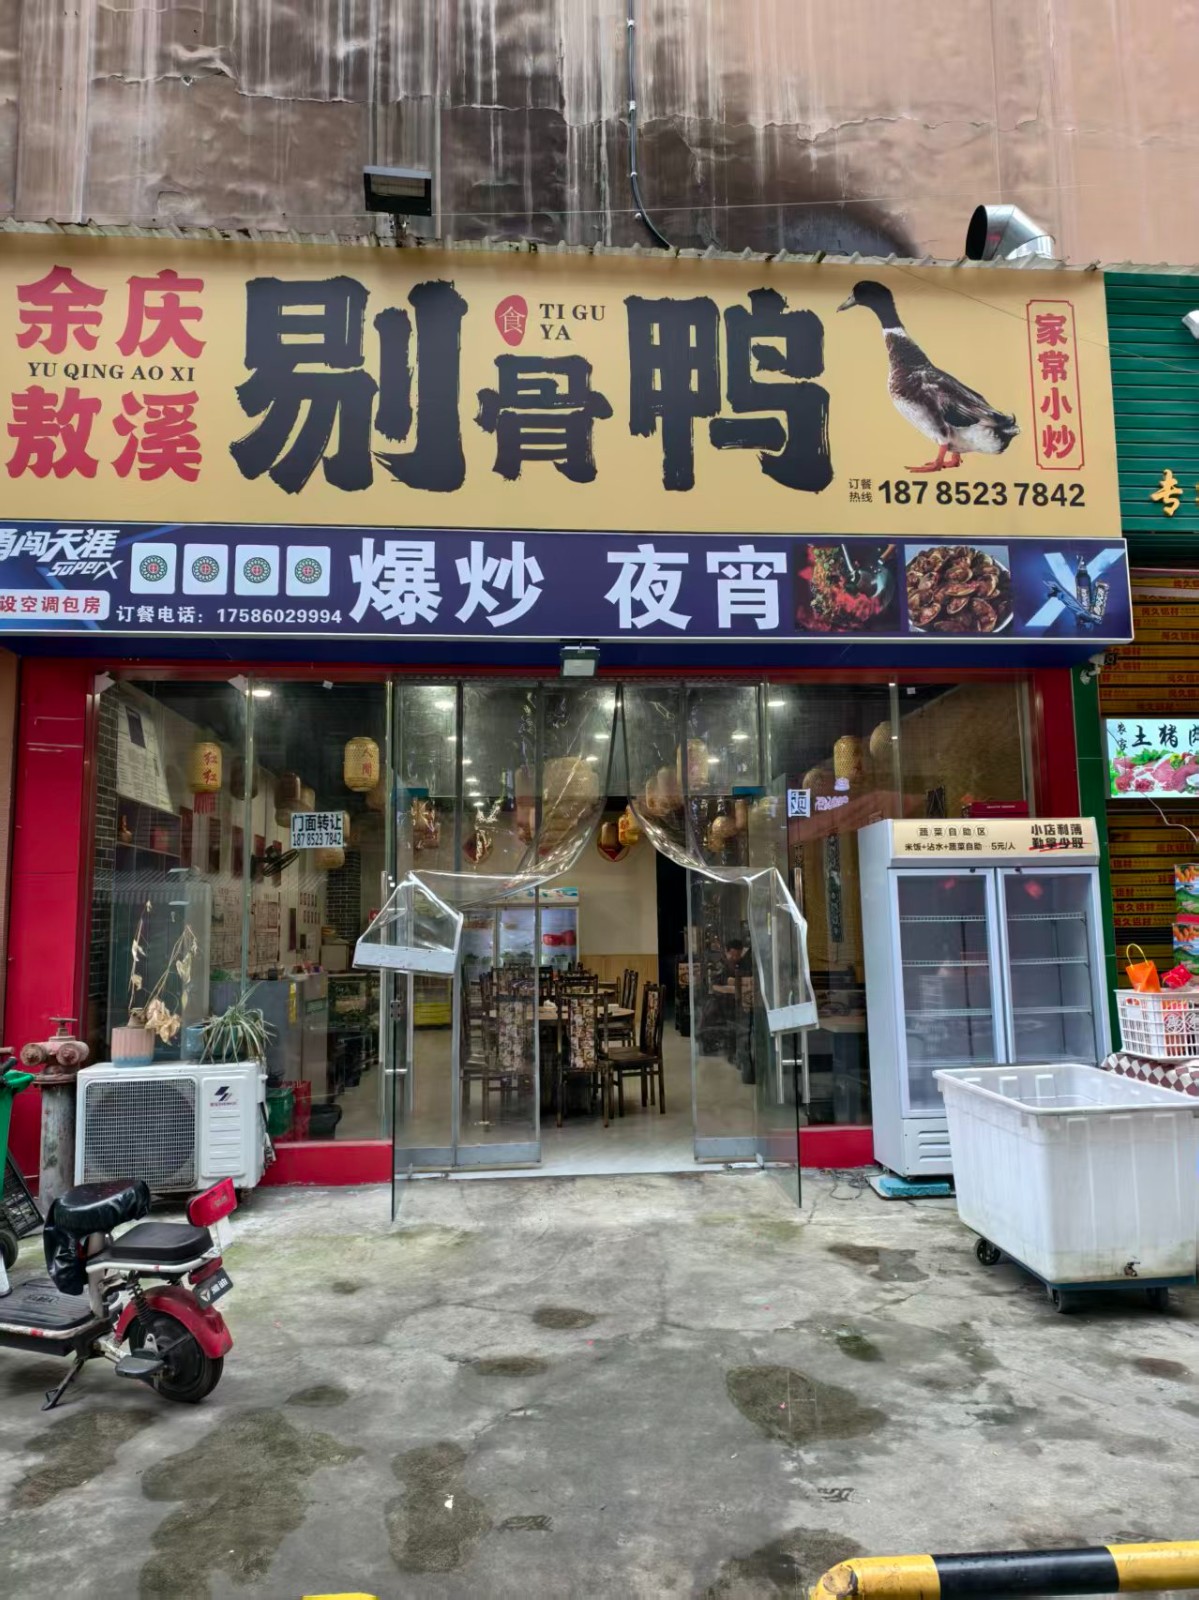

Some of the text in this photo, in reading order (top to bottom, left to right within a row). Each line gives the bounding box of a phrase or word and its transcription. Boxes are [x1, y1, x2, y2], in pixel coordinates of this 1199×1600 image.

[16, 264, 207, 359] 余庆
[499, 306, 526, 334] 食
[539, 303, 606, 321] TI GU
[540, 324, 571, 340] YA
[28, 362, 195, 382] YU QING AO XI
[229, 275, 835, 496] 剔骨鸭
[1035, 312, 1076, 460] 家常小炒
[5, 384, 203, 482] 敖溪
[848, 478, 872, 489] 订餐
[849, 491, 873, 503] 热线
[878, 480, 1085, 507] 187 8523 7842
[349, 537, 788, 630] 爆炒 夜宵
[217, 608, 342, 624] 17586029994
[292, 813, 342, 832] 门面转让
[1031, 823, 1082, 836] 小店利薄
[292, 831, 342, 847] 187 8523 7842
